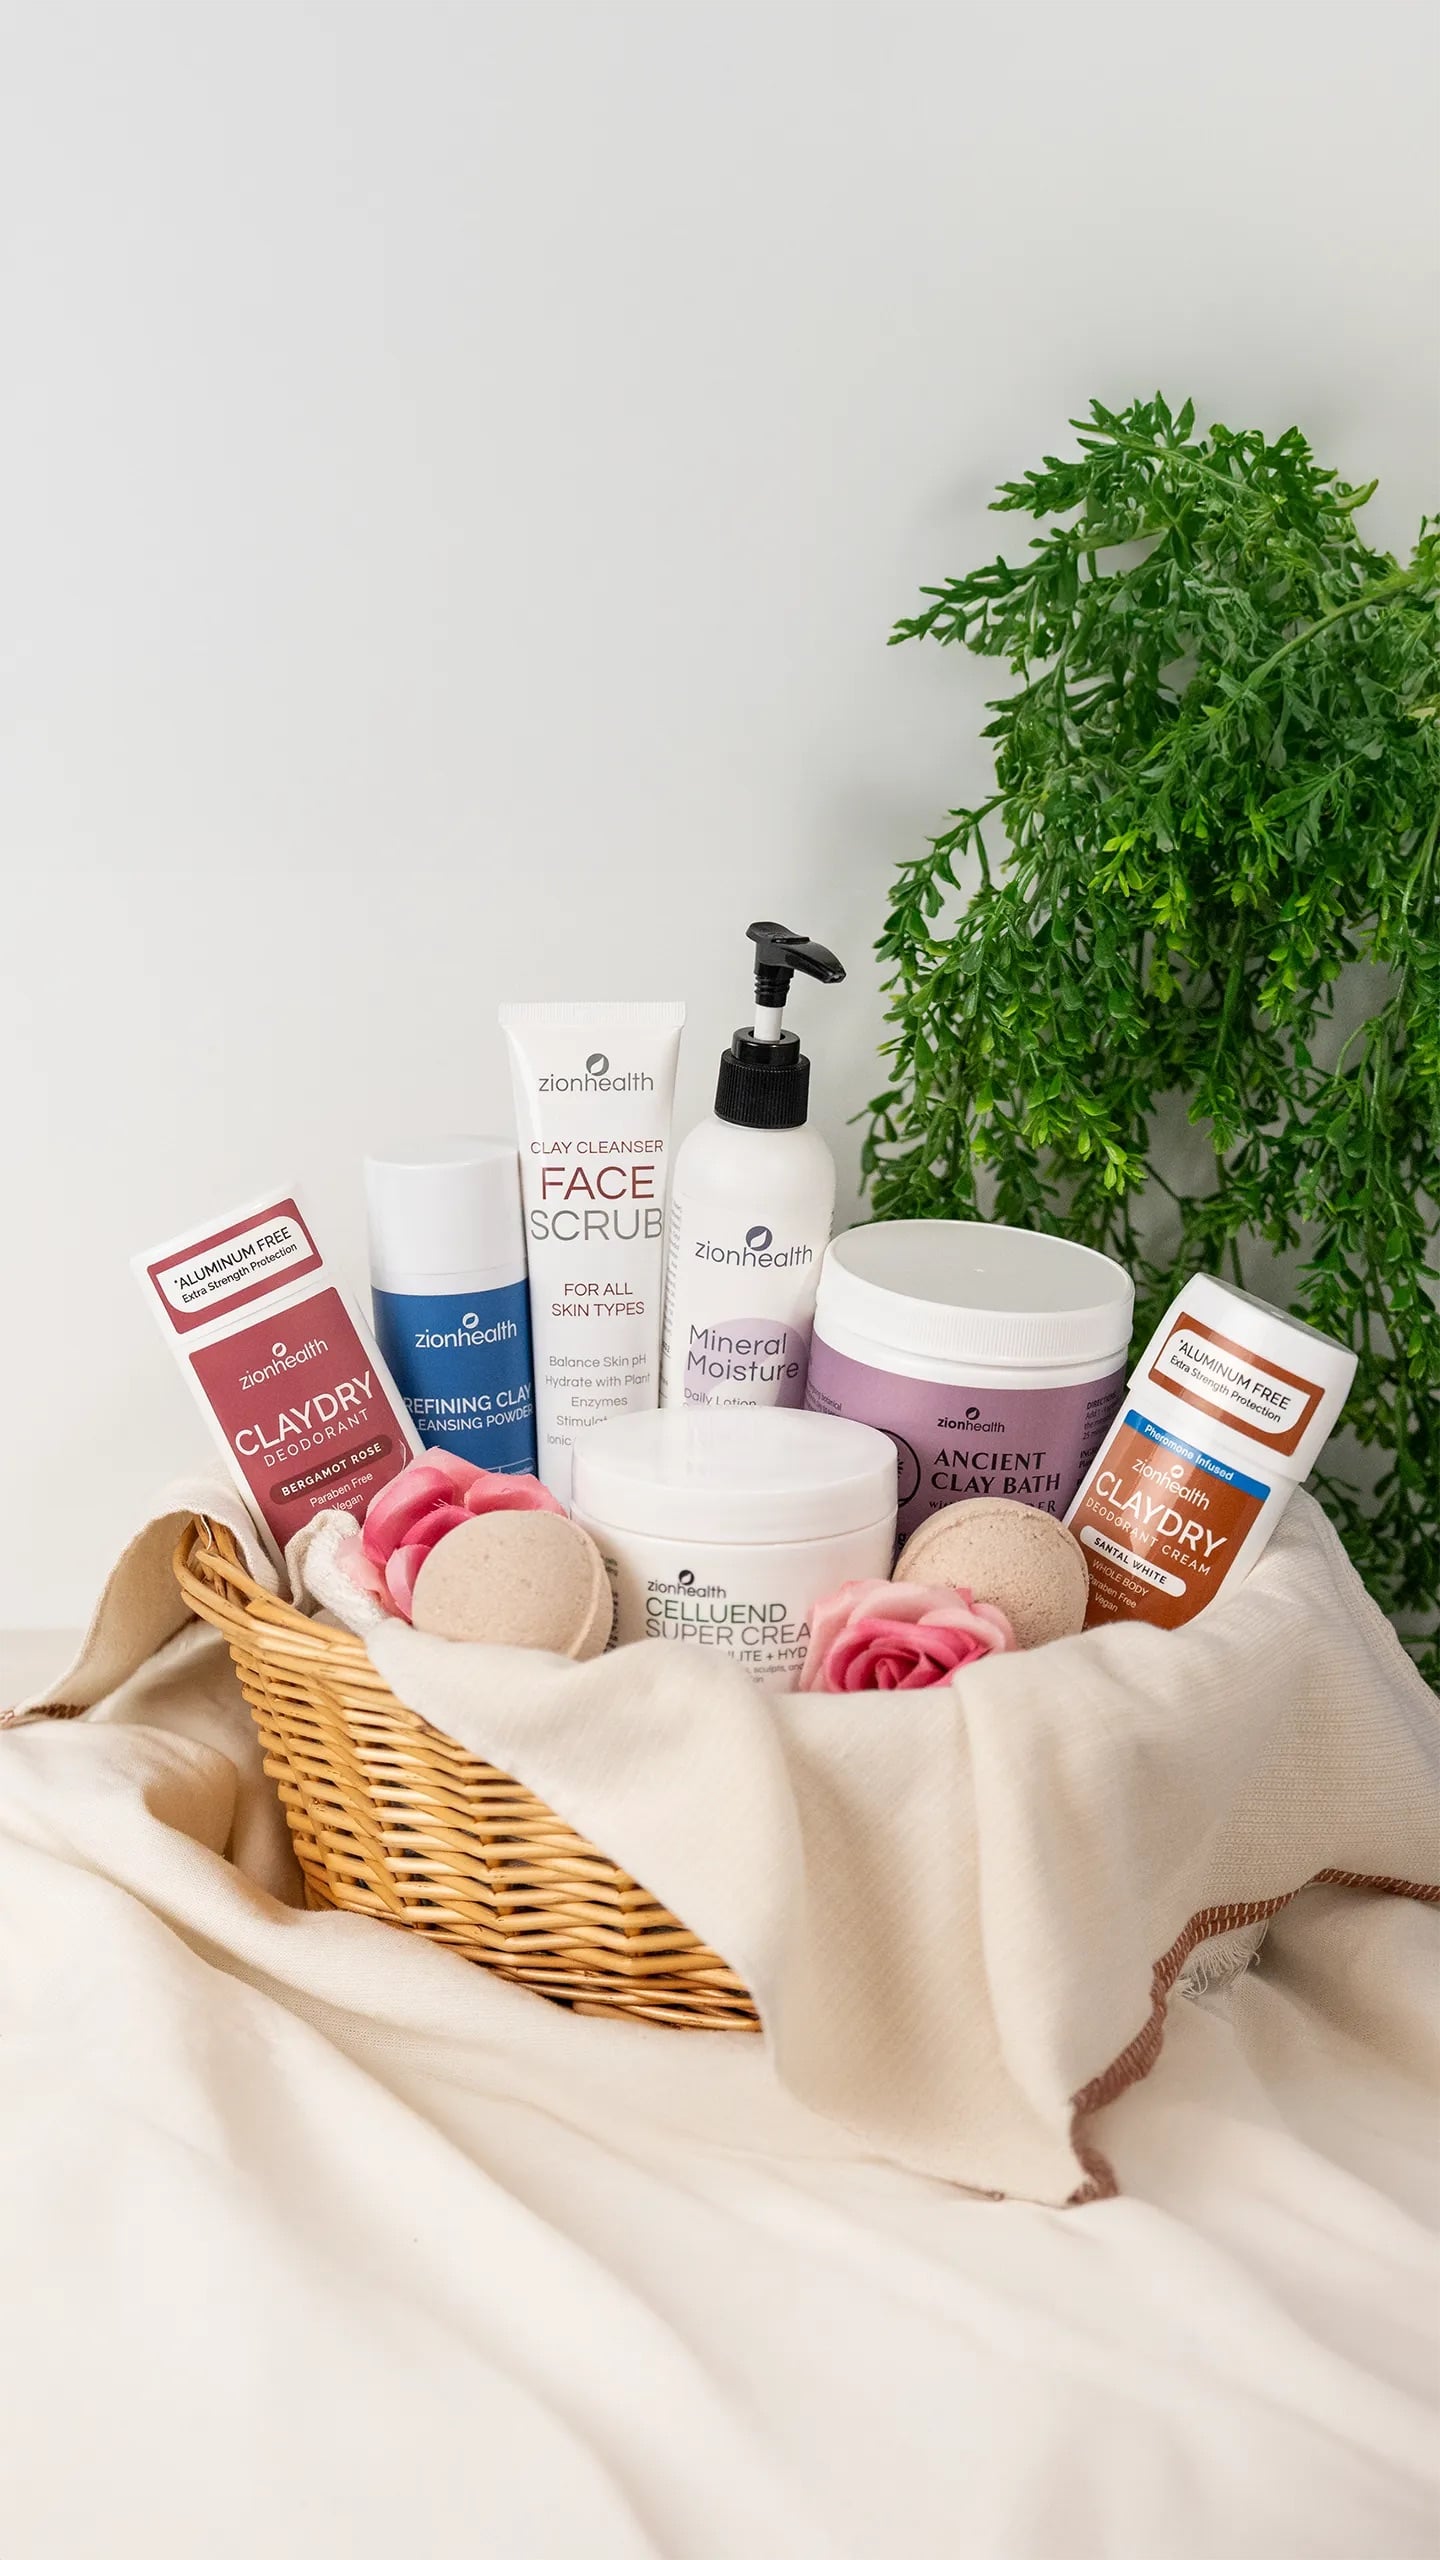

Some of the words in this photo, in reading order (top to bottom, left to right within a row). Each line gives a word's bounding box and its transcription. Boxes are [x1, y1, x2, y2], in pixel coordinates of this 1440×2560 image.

[539, 1072, 653, 1092] zionhealth
[530, 1141, 572, 1154] CLAY
[576, 1140, 663, 1153] CLEANSER
[542, 1165, 655, 1200] FACE
[530, 1208, 663, 1241] SCRUB
[256, 1226, 292, 1255] FREE
[695, 1241, 813, 1268] zionhealth
[182, 1285, 208, 1304] Extra
[207, 1263, 249, 1292] Strength
[248, 1243, 297, 1274] Protection
[564, 1283, 599, 1296] FOR
[603, 1283, 633, 1295] ALL
[552, 1304, 589, 1316] SKIN
[594, 1302, 645, 1316] TYPES
[415, 1320, 517, 1348] zionhealth
[689, 1324, 787, 1355] Mineral
[239, 1339, 328, 1391] zionhealth
[549, 1356, 600, 1368] Balance
[603, 1356, 629, 1367] Skin
[632, 1355, 647, 1369] pH
[687, 1351, 799, 1381] Moisture
[496, 1382, 531, 1406] CLAY
[546, 1375, 593, 1388] Hydrate
[597, 1375, 621, 1387] with
[624, 1374, 650, 1385] Plant
[1170, 1356, 1190, 1373] Extra
[1189, 1367, 1231, 1395] Strength
[1230, 1389, 1282, 1423] Protection
[571, 1396, 628, 1409] Enzymes
[684, 1388, 712, 1405] Daily
[1253, 1382, 1291, 1410] FREE
[235, 1371, 375, 1457] CLAYDRY
[486, 1404, 533, 1428] POWDER
[937, 1416, 1005, 1433] zionhealth
[264, 1409, 370, 1467] DEODORANT
[933, 1448, 1046, 1471] ANCIENT
[1144, 1423, 1193, 1460] Pheromone
[1195, 1453, 1234, 1481] Infused
[281, 1460, 349, 1497] BERGAMOT
[351, 1442, 383, 1467] ROSE
[931, 1472, 996, 1494] CLAY
[1002, 1473, 1061, 1494] BATH
[309, 1483, 353, 1508] Paraben
[351, 1472, 374, 1492] Free
[1131, 1458, 1210, 1511] zionhealth
[332, 1493, 363, 1514] Vegan
[1095, 1471, 1228, 1559] CLAYDRY
[1085, 1497, 1157, 1547] DEODORANT
[1161, 1545, 1212, 1576] CREAM
[1094, 1536, 1130, 1565] SANTAL
[1131, 1559, 1167, 1585] WHITE
[647, 1580, 727, 1598] zionhealth
[1092, 1559, 1121, 1582] WHOLE
[1122, 1578, 1149, 1596] BODY
[646, 1597, 786, 1624] CELLUEND
[1095, 1593, 1118, 1611] Vegan
[1118, 1593, 1136, 1608] Free
[646, 1619, 734, 1645] SUPER
[741, 1622, 811, 1646] CREA
[778, 1647, 807, 1660] HYD
